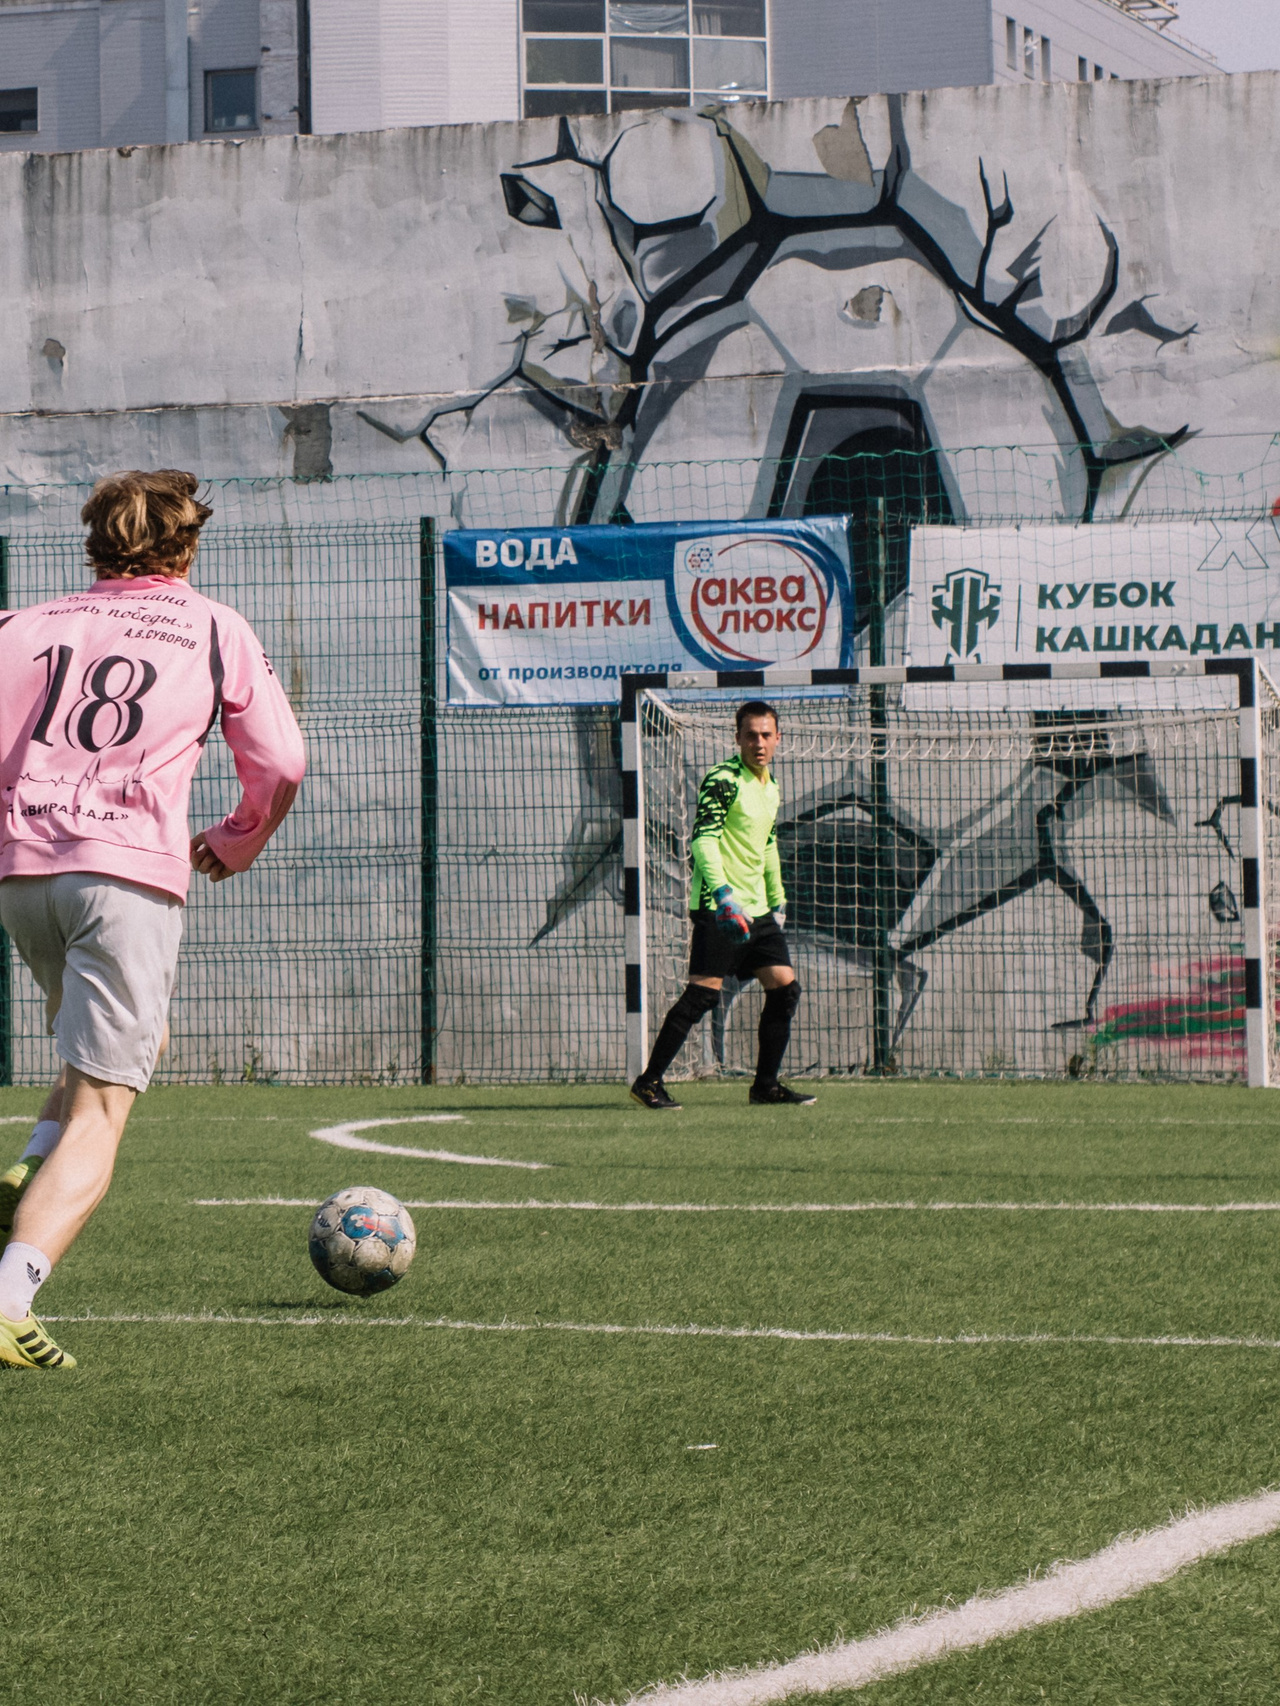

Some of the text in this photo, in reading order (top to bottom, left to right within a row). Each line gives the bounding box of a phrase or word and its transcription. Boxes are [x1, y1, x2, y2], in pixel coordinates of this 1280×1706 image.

[475, 537, 579, 571] ВОДА
[701, 573, 806, 607] аква
[1037, 581, 1176, 609] КУБОК
[477, 599, 652, 631] НАПИТКИ
[716, 608, 818, 635] люкс
[478, 667, 500, 680] от
[30, 644, 158, 753] 18
